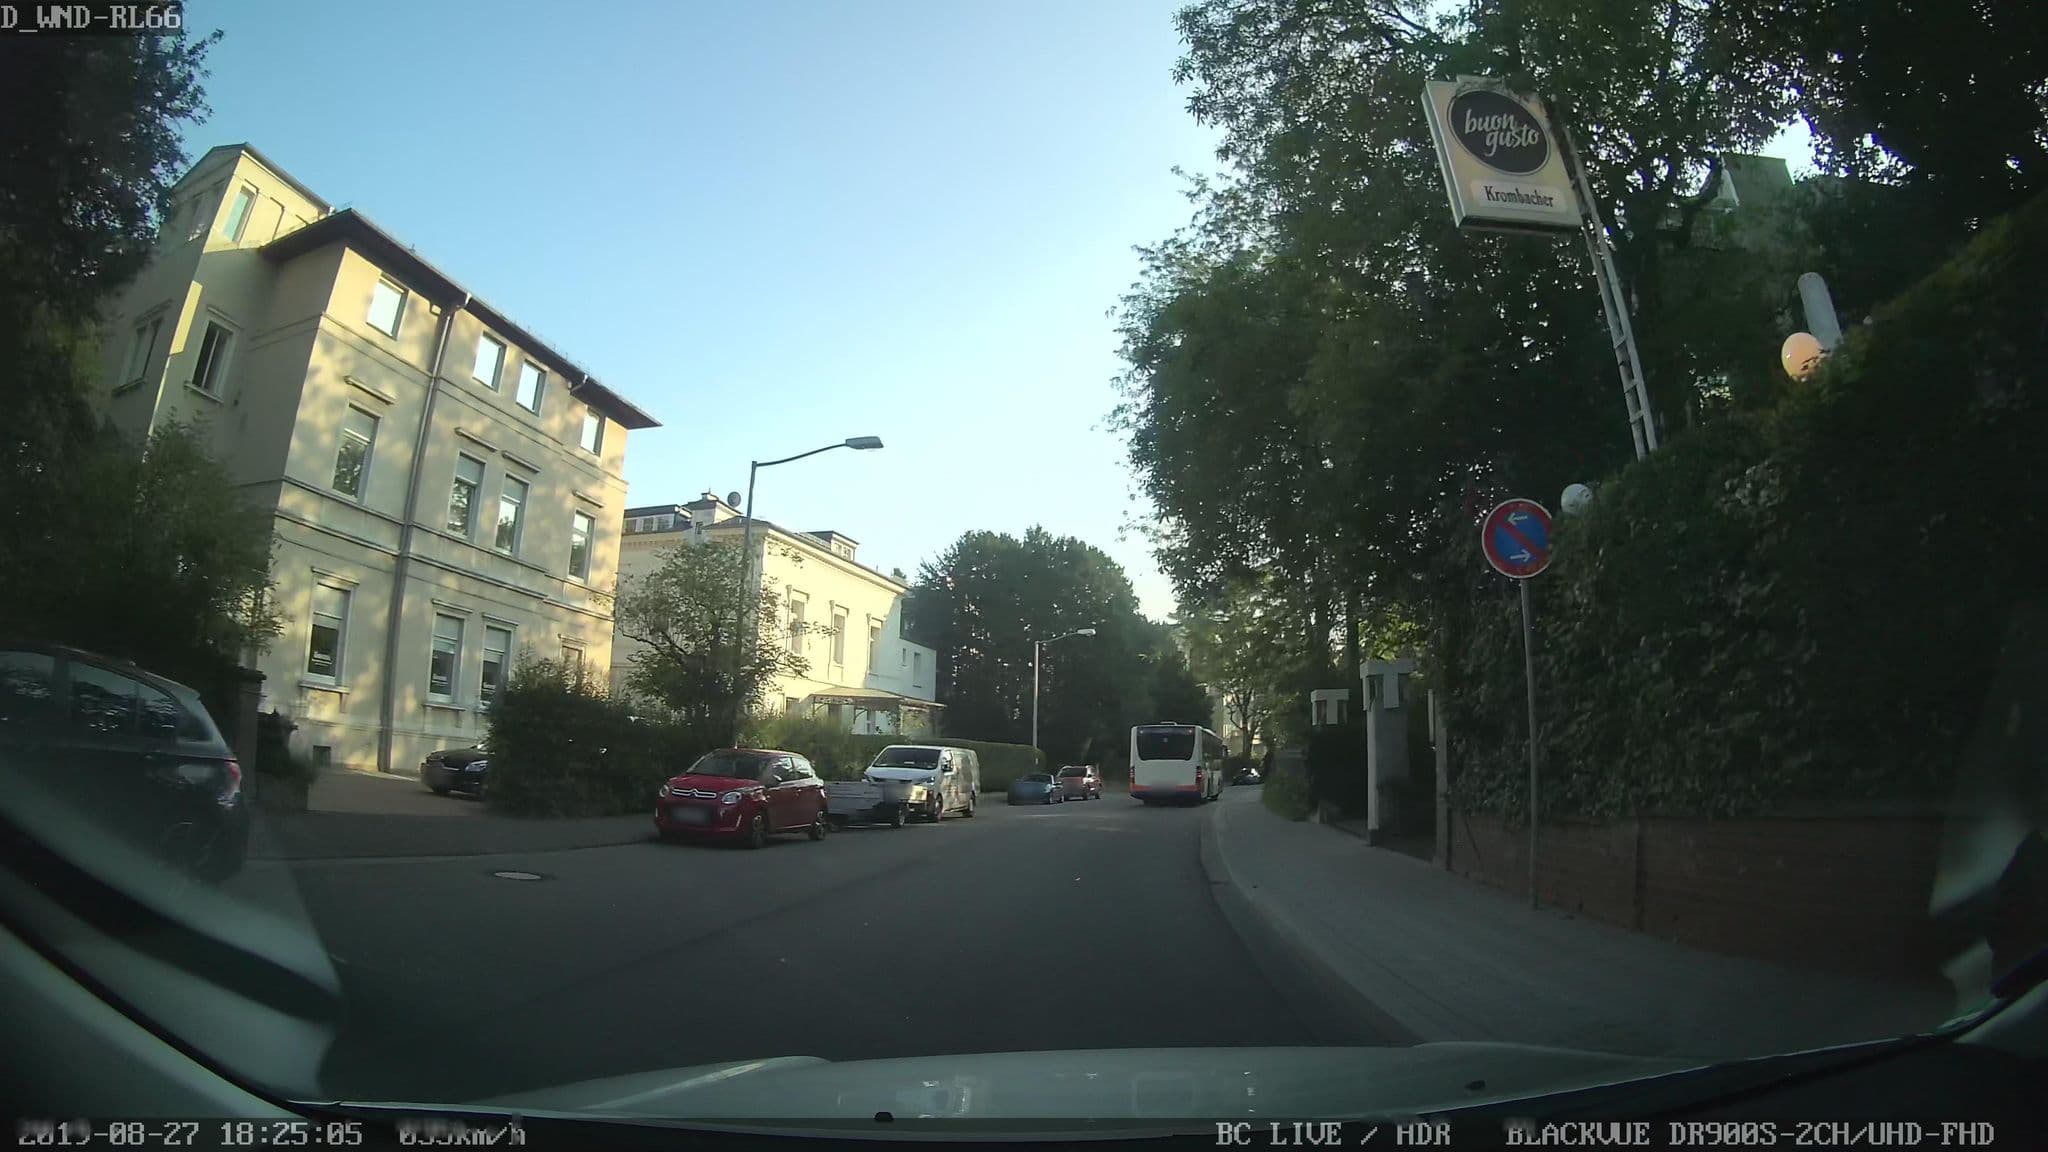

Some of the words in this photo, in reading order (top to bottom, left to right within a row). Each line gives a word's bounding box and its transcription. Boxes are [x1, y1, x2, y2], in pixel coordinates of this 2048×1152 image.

[1464, 108, 1518, 134] buon
[1484, 123, 1540, 157] gusto
[1483, 185, 1554, 207] Krombacher
